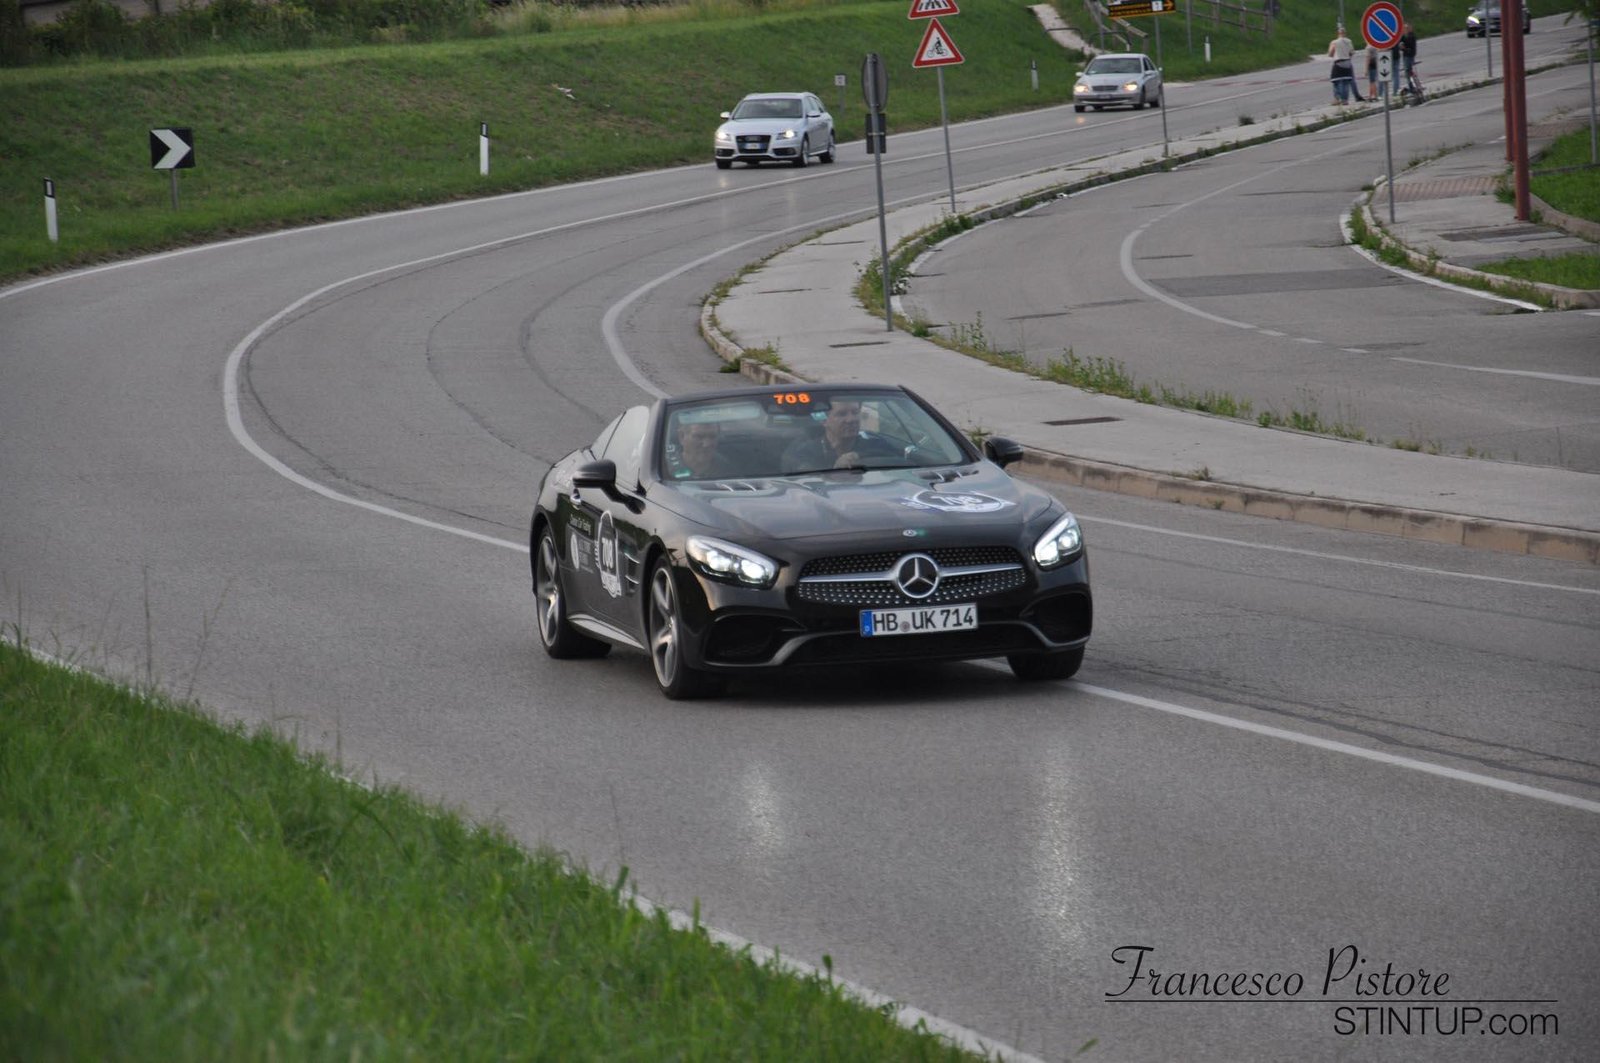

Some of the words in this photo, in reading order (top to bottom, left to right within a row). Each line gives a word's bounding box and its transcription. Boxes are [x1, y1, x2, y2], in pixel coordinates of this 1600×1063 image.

[773, 392, 811, 405] 708
[873, 612, 899, 633] HB
[911, 609, 937, 631] UK
[940, 606, 974, 628] 714
